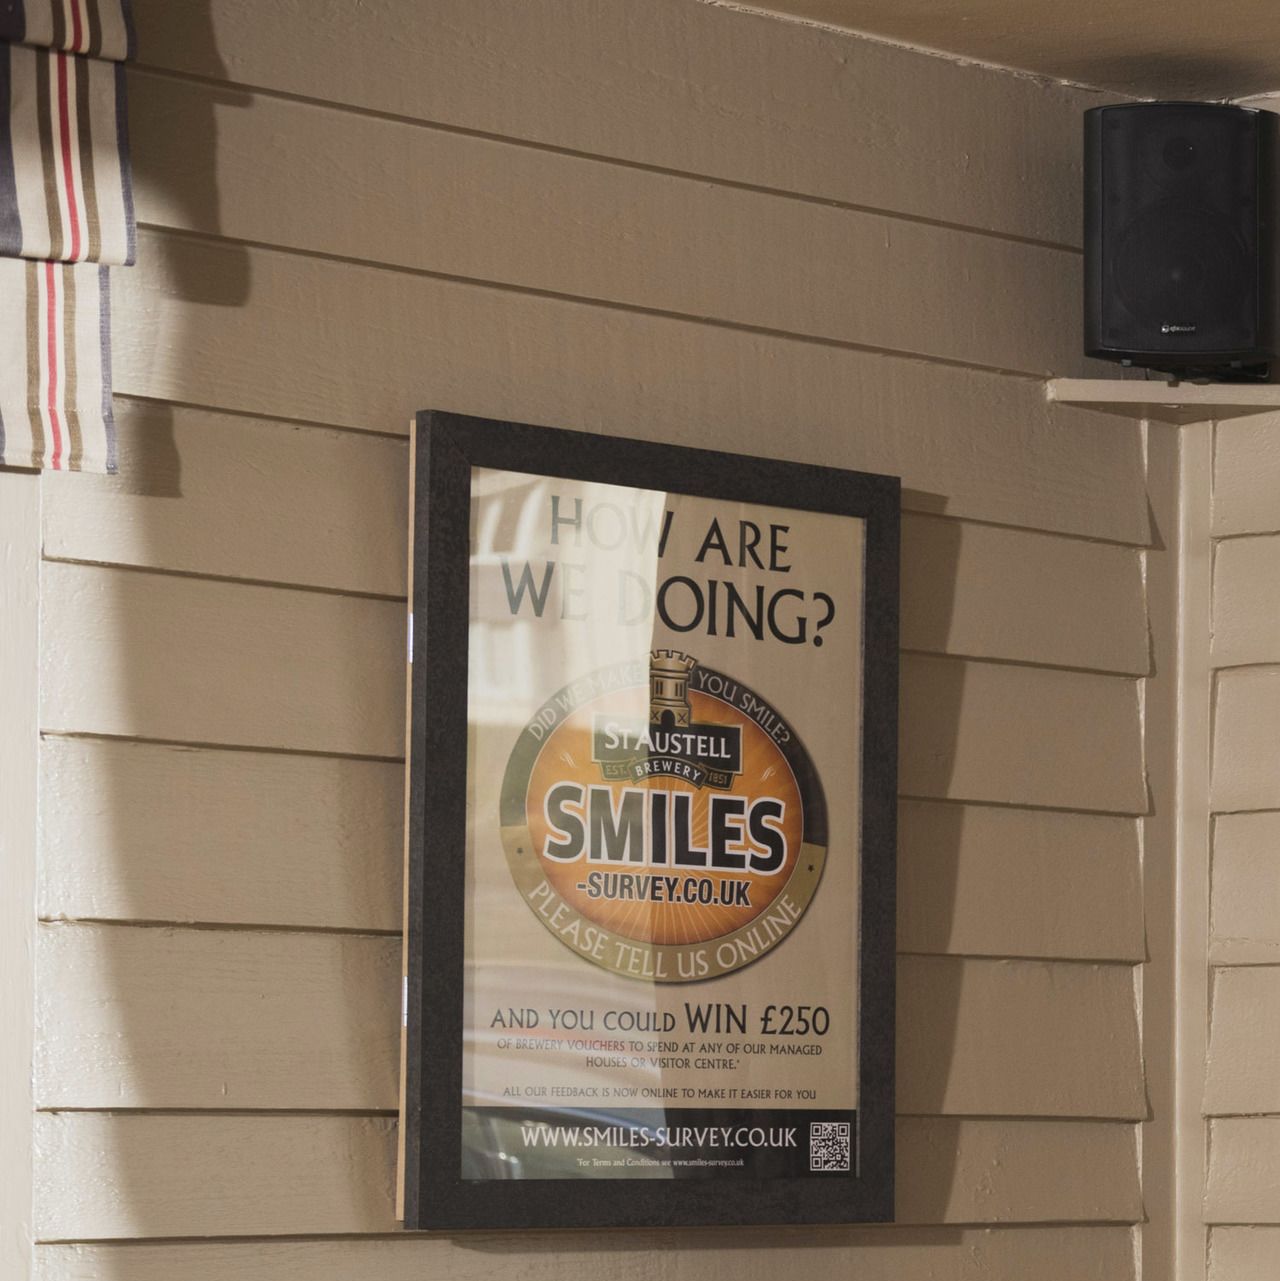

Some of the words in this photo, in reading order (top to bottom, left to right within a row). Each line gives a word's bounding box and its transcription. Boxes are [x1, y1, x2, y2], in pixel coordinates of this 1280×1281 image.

[550, 495, 674, 559] HOW
[695, 516, 792, 573] ARE
[501, 558, 588, 621] WE
[616, 568, 836, 648] DOING?
[528, 708, 557, 741] DID
[556, 684, 586, 711] WE
[698, 670, 735, 702] YOU
[739, 693, 790, 744] SMILE?
[634, 724, 731, 759] AUSTELL
[635, 760, 702, 782] BREWERY
[708, 772, 728, 784] 1851
[543, 781, 787, 876] SMILES
[577, 870, 752, 907] -SURVEY.CO.UK
[528, 880, 609, 960] PLEASE
[615, 941, 668, 978] TELL
[677, 948, 710, 978] US
[716, 894, 802, 969] ONLINE
[490, 1008, 540, 1029] AND
[548, 1009, 594, 1031] YOU
[603, 1011, 676, 1033] COULD
[684, 1002, 748, 1034] WIN
[760, 1005, 830, 1036] £250
[497, 1038, 513, 1050] OF
[516, 1038, 563, 1050] BREWERY
[567, 1040, 625, 1052] VOUCHERS
[629, 1041, 644, 1052] TO
[647, 1041, 679, 1053] SPEND
[682, 1042, 696, 1053] AT
[698, 1043, 724, 1054] ANY
[726, 1043, 741, 1054] OF
[743, 1043, 766, 1055] OUR
[769, 1044, 823, 1056] MANAGED
[586, 1056, 628, 1068] HOUSES
[630, 1057, 646, 1068] OR
[649, 1057, 691, 1069] VISITOR
[503, 1086, 521, 1097] ALL
[524, 1086, 547, 1098] OUR
[551, 1086, 599, 1098] FEEDBACK
[602, 1087, 610, 1098] IS
[613, 1087, 638, 1098] NOW
[641, 1087, 678, 1099] ONLINE
[681, 1088, 695, 1099] TO
[698, 1088, 726, 1099] MAKE
[728, 1088, 737, 1099] IT
[740, 1089, 771, 1100] EASIER
[774, 1089, 793, 1100] FOR
[796, 1089, 816, 1100] YOU
[520, 1125, 798, 1148] WWW.SMILES-SURVEY.CO.UK
[612, 1158, 625, 1167] and
